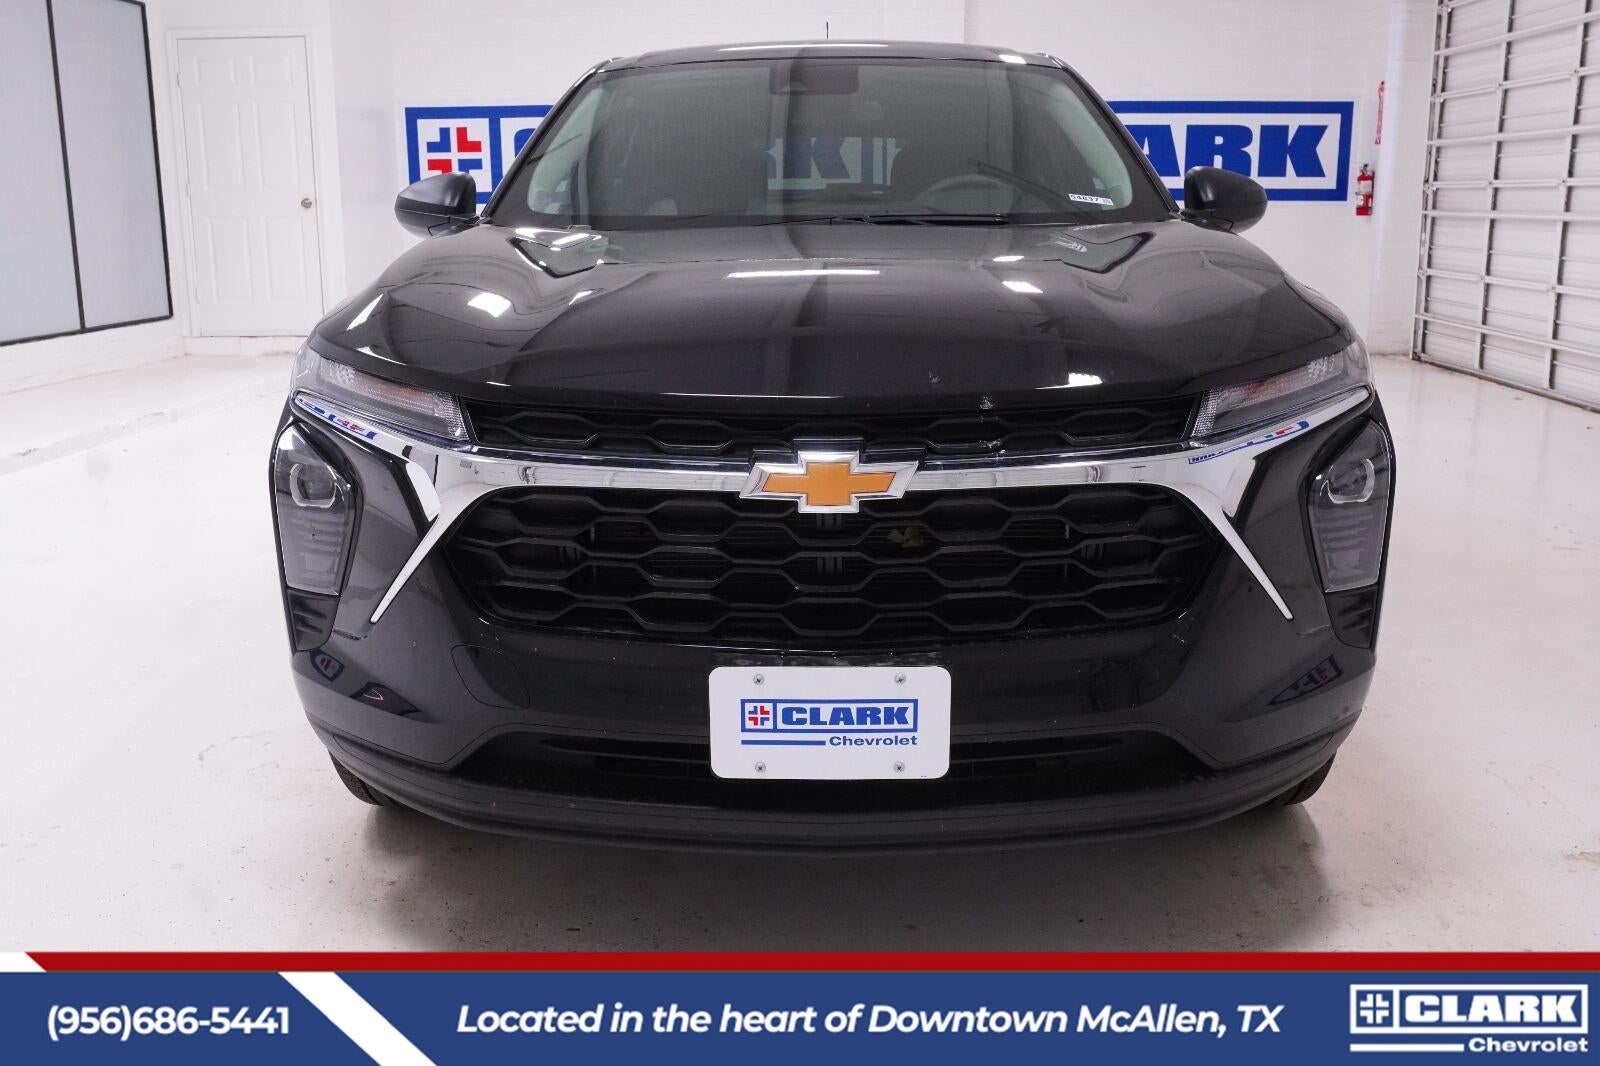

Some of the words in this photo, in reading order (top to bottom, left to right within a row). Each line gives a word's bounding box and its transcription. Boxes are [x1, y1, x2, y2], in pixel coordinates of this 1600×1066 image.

[1125, 124, 1329, 178] ARK
[781, 706, 910, 726] CLARK
[829, 735, 918, 746] Chevrolet
